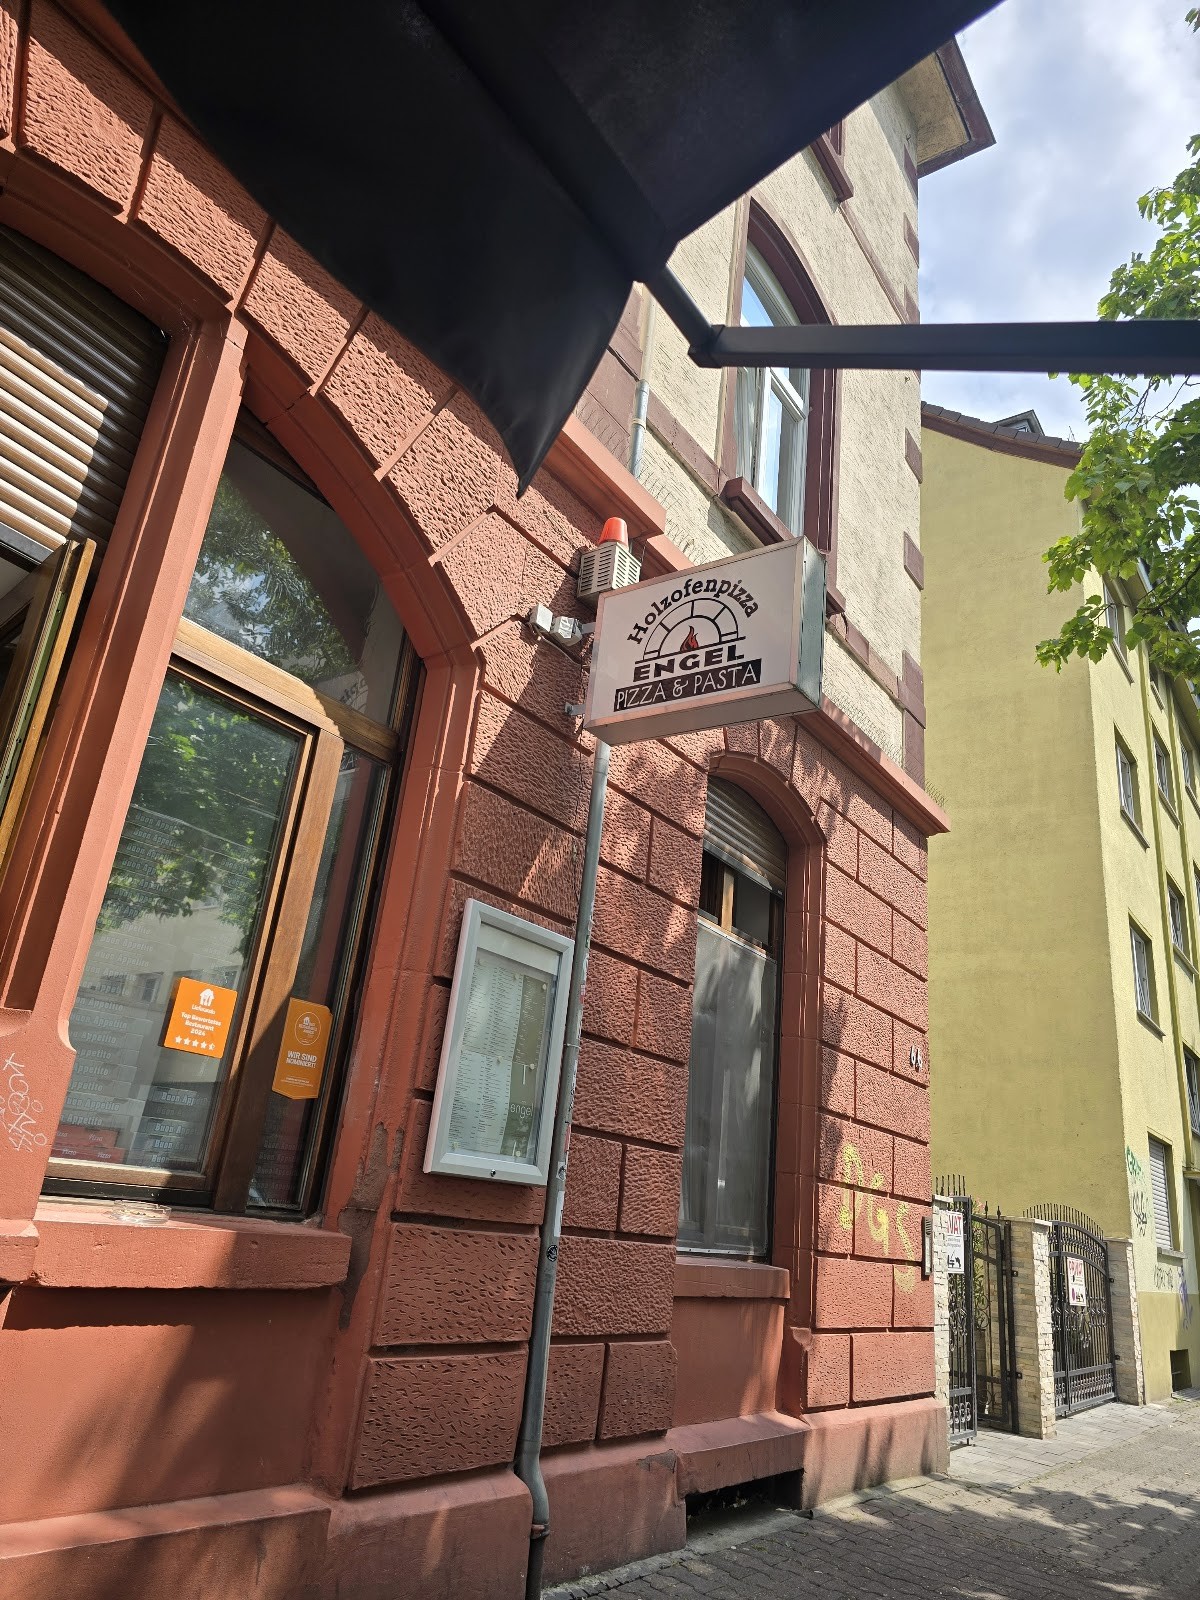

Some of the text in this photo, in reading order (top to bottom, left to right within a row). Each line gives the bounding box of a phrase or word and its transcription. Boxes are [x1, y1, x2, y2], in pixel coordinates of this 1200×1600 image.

[627, 578, 759, 645] Holzofenpizza
[633, 644, 745, 682] ENGEL
[616, 664, 757, 710] PIZZA & PASTA
[287, 1050, 318, 1063] WIR SIND
[69, 1080, 104, 1092] ppetito
[65, 1096, 83, 1107] uon
